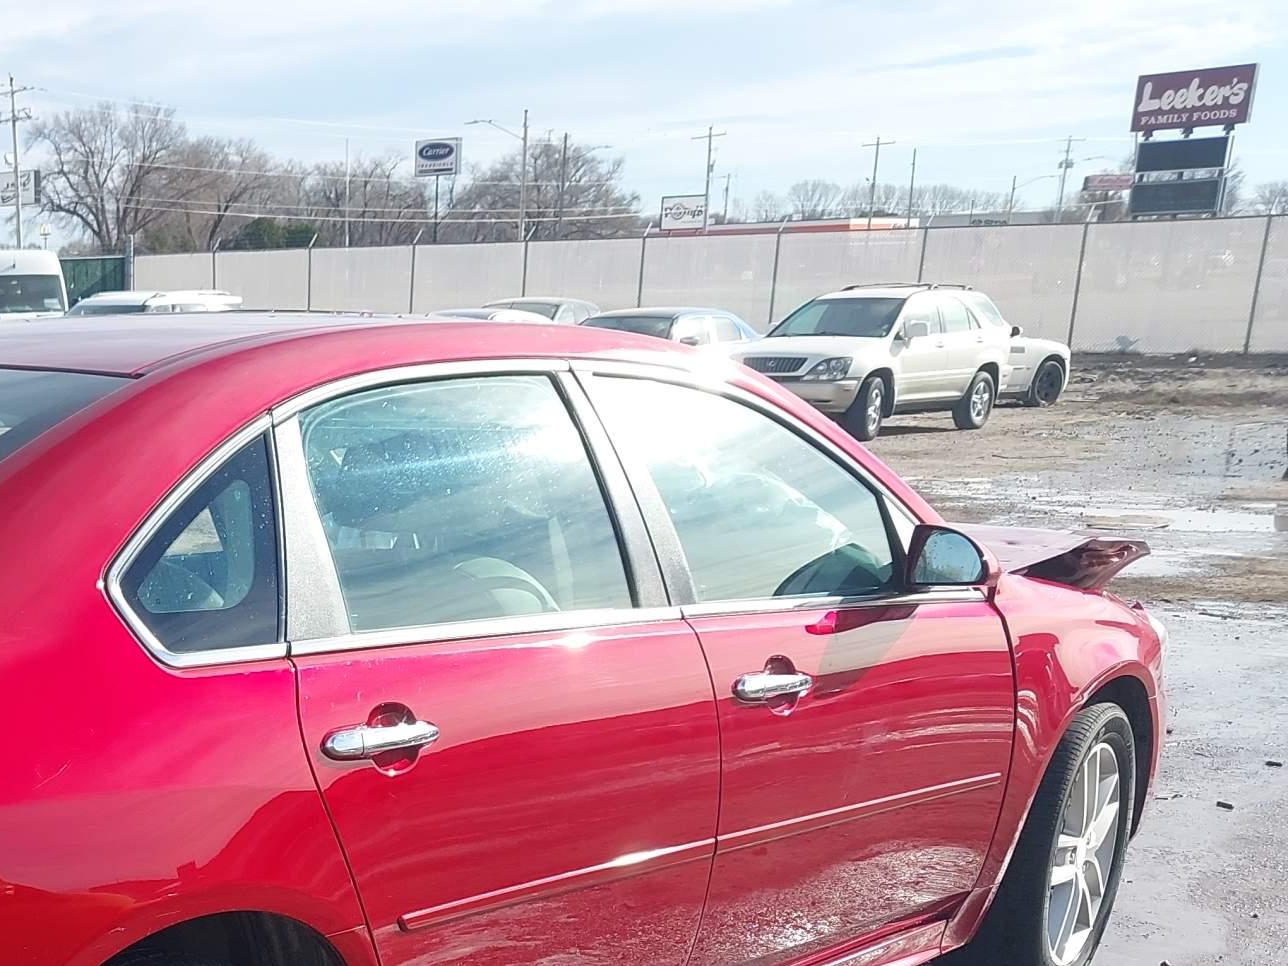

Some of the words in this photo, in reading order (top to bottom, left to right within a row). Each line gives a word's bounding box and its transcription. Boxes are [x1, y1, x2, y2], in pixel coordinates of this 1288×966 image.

[1137, 77, 1249, 112] Leeker's
[1140, 113, 1190, 125] FAMILY
[1192, 109, 1237, 121] FOODS
